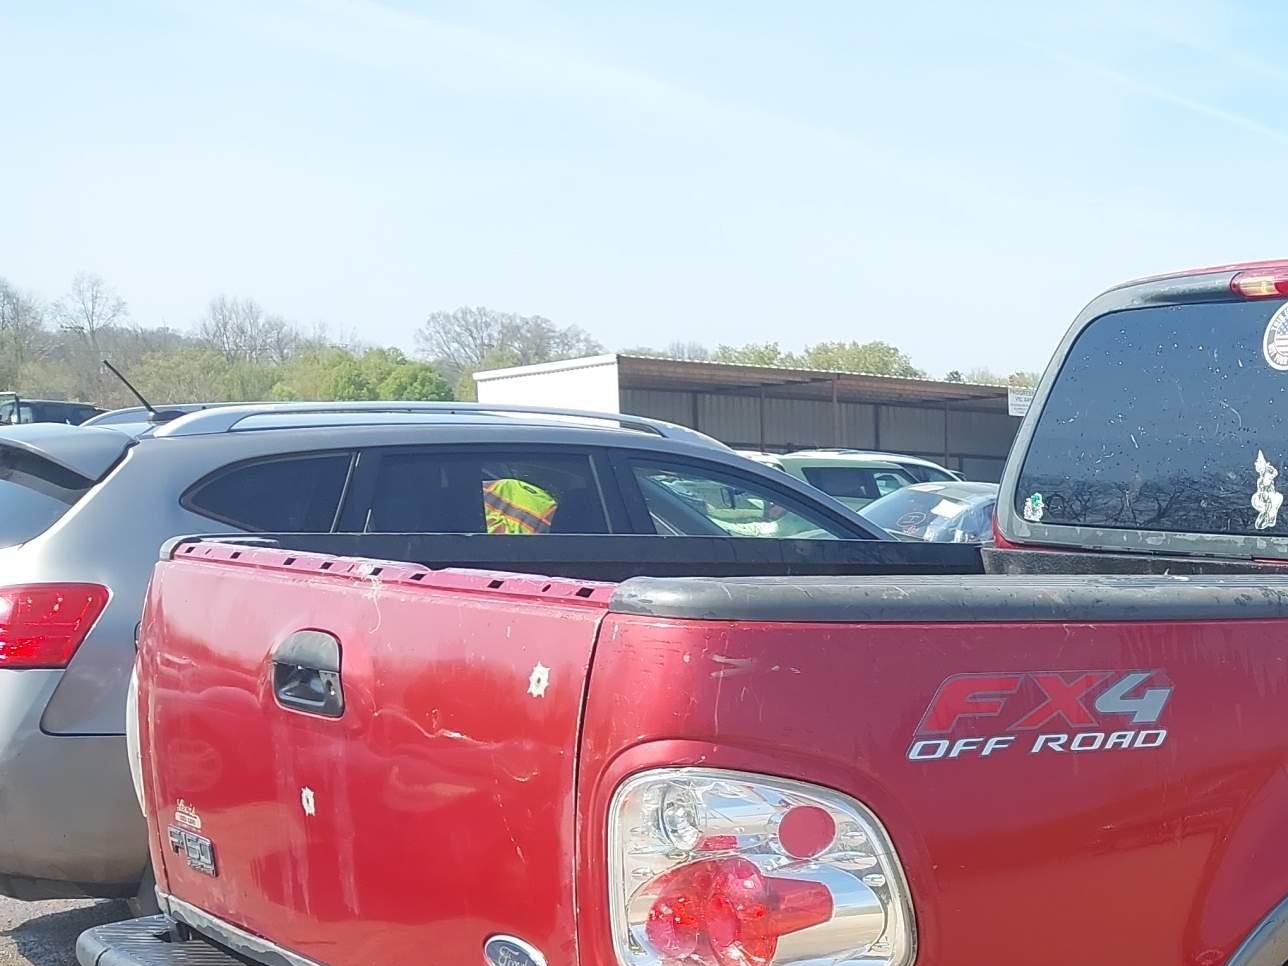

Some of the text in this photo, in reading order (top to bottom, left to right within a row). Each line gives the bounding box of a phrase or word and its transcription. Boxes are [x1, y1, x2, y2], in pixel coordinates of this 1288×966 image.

[916, 672, 1171, 734] FX4
[907, 729, 1167, 760] OFF ROAD
